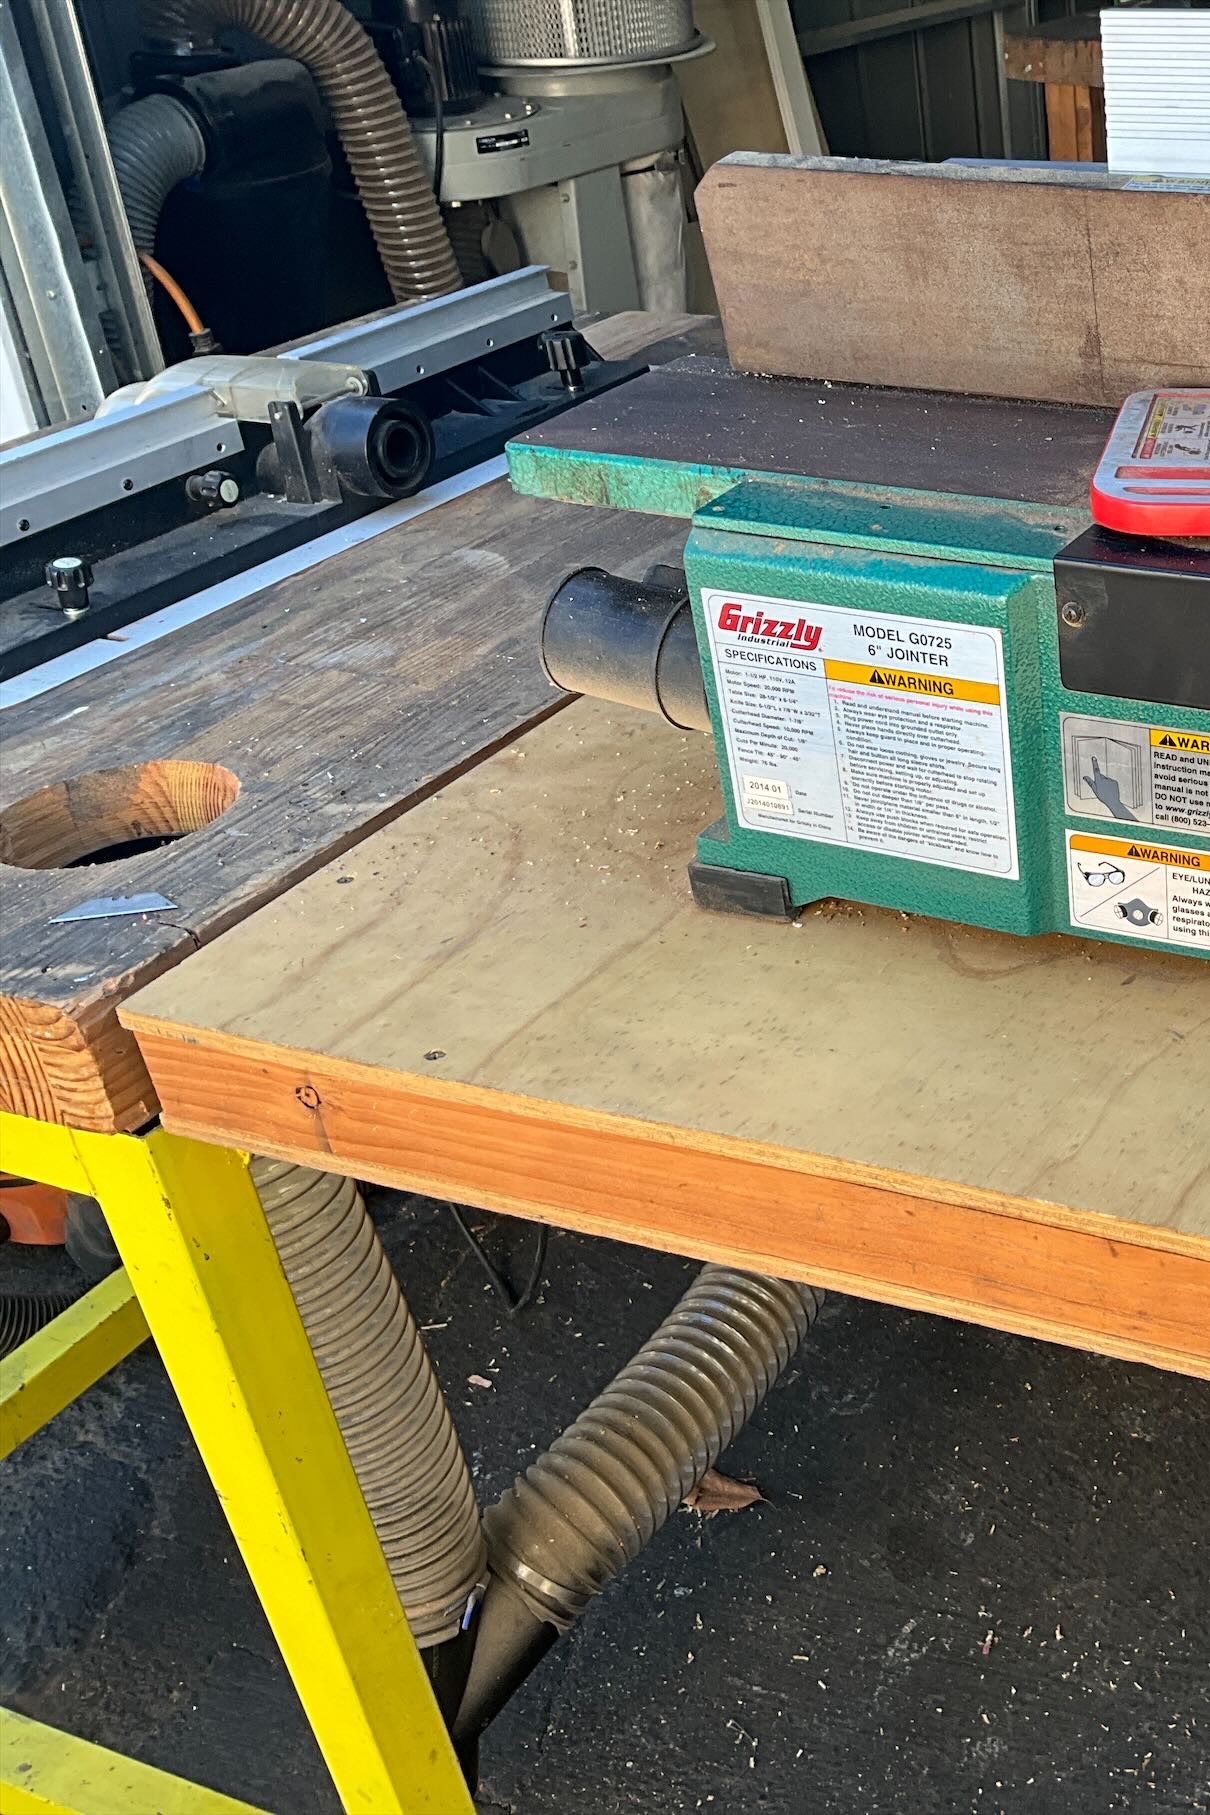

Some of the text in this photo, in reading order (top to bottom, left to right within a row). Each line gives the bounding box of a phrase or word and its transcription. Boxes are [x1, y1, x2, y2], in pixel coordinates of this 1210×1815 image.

[718, 602, 823, 651] Grizzly
[737, 633, 790, 648] Industrial
[853, 624, 952, 650] MODEL G0725
[725, 649, 817, 672] SPECIFICATIONS
[867, 644, 949, 667] 6" JOINTER
[883, 673, 954, 696] WARNING
[1153, 752, 1178, 762] READ
[1179, 755, 1195, 764] and
[1154, 772, 1176, 782] avoid
[1178, 776, 1209, 786] serious
[1154, 782, 1184, 793] manual
[1186, 787, 1193, 795] is
[1195, 788, 1208, 797] not
[1155, 793, 1167, 801] DO
[1169, 795, 1187, 804] NOT
[1189, 798, 1204, 806] use
[1155, 813, 1170, 821] call
[1171, 815, 1191, 826] (800)
[1139, 848, 1200, 867] WARNING
[1172, 895, 1203, 907] Always
[1172, 905, 1205, 917] glasses
[1173, 925, 1196, 936] using
